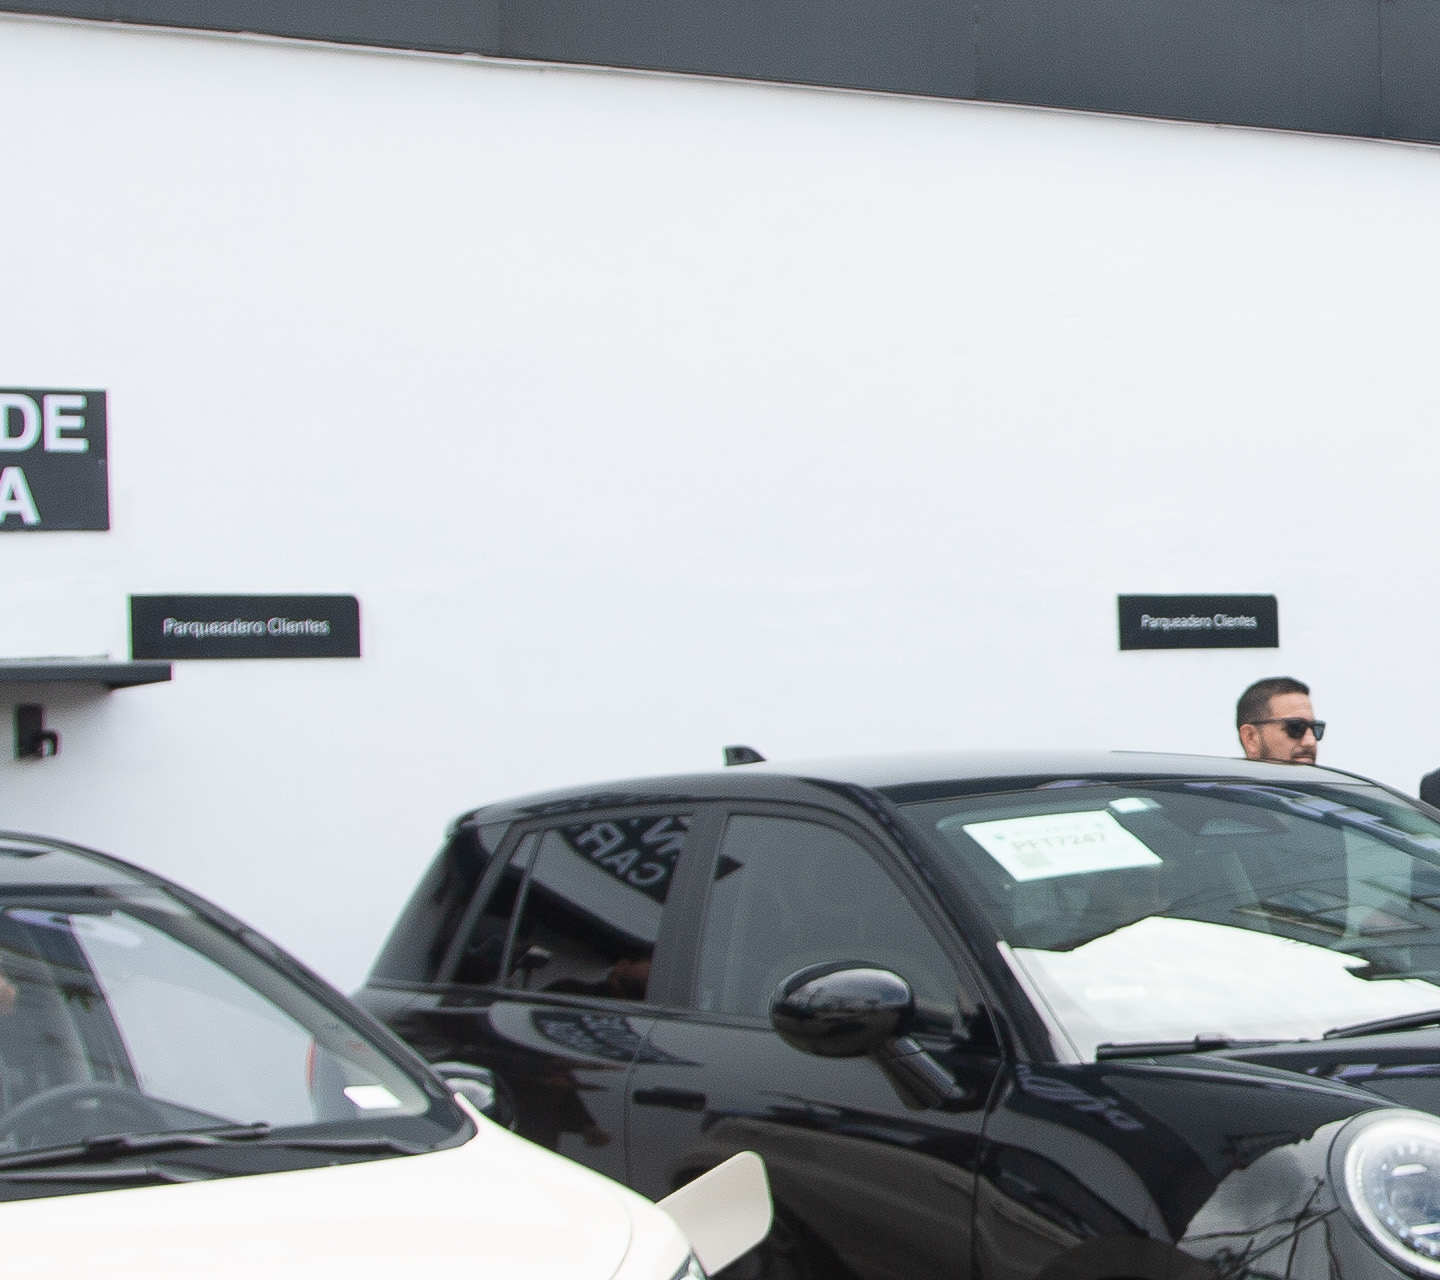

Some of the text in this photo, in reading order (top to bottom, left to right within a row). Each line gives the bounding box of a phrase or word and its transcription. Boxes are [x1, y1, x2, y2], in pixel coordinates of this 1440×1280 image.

[163, 616, 331, 640] Parqueadero Clientes
[1141, 613, 1258, 631] Parqueadero Clientes
